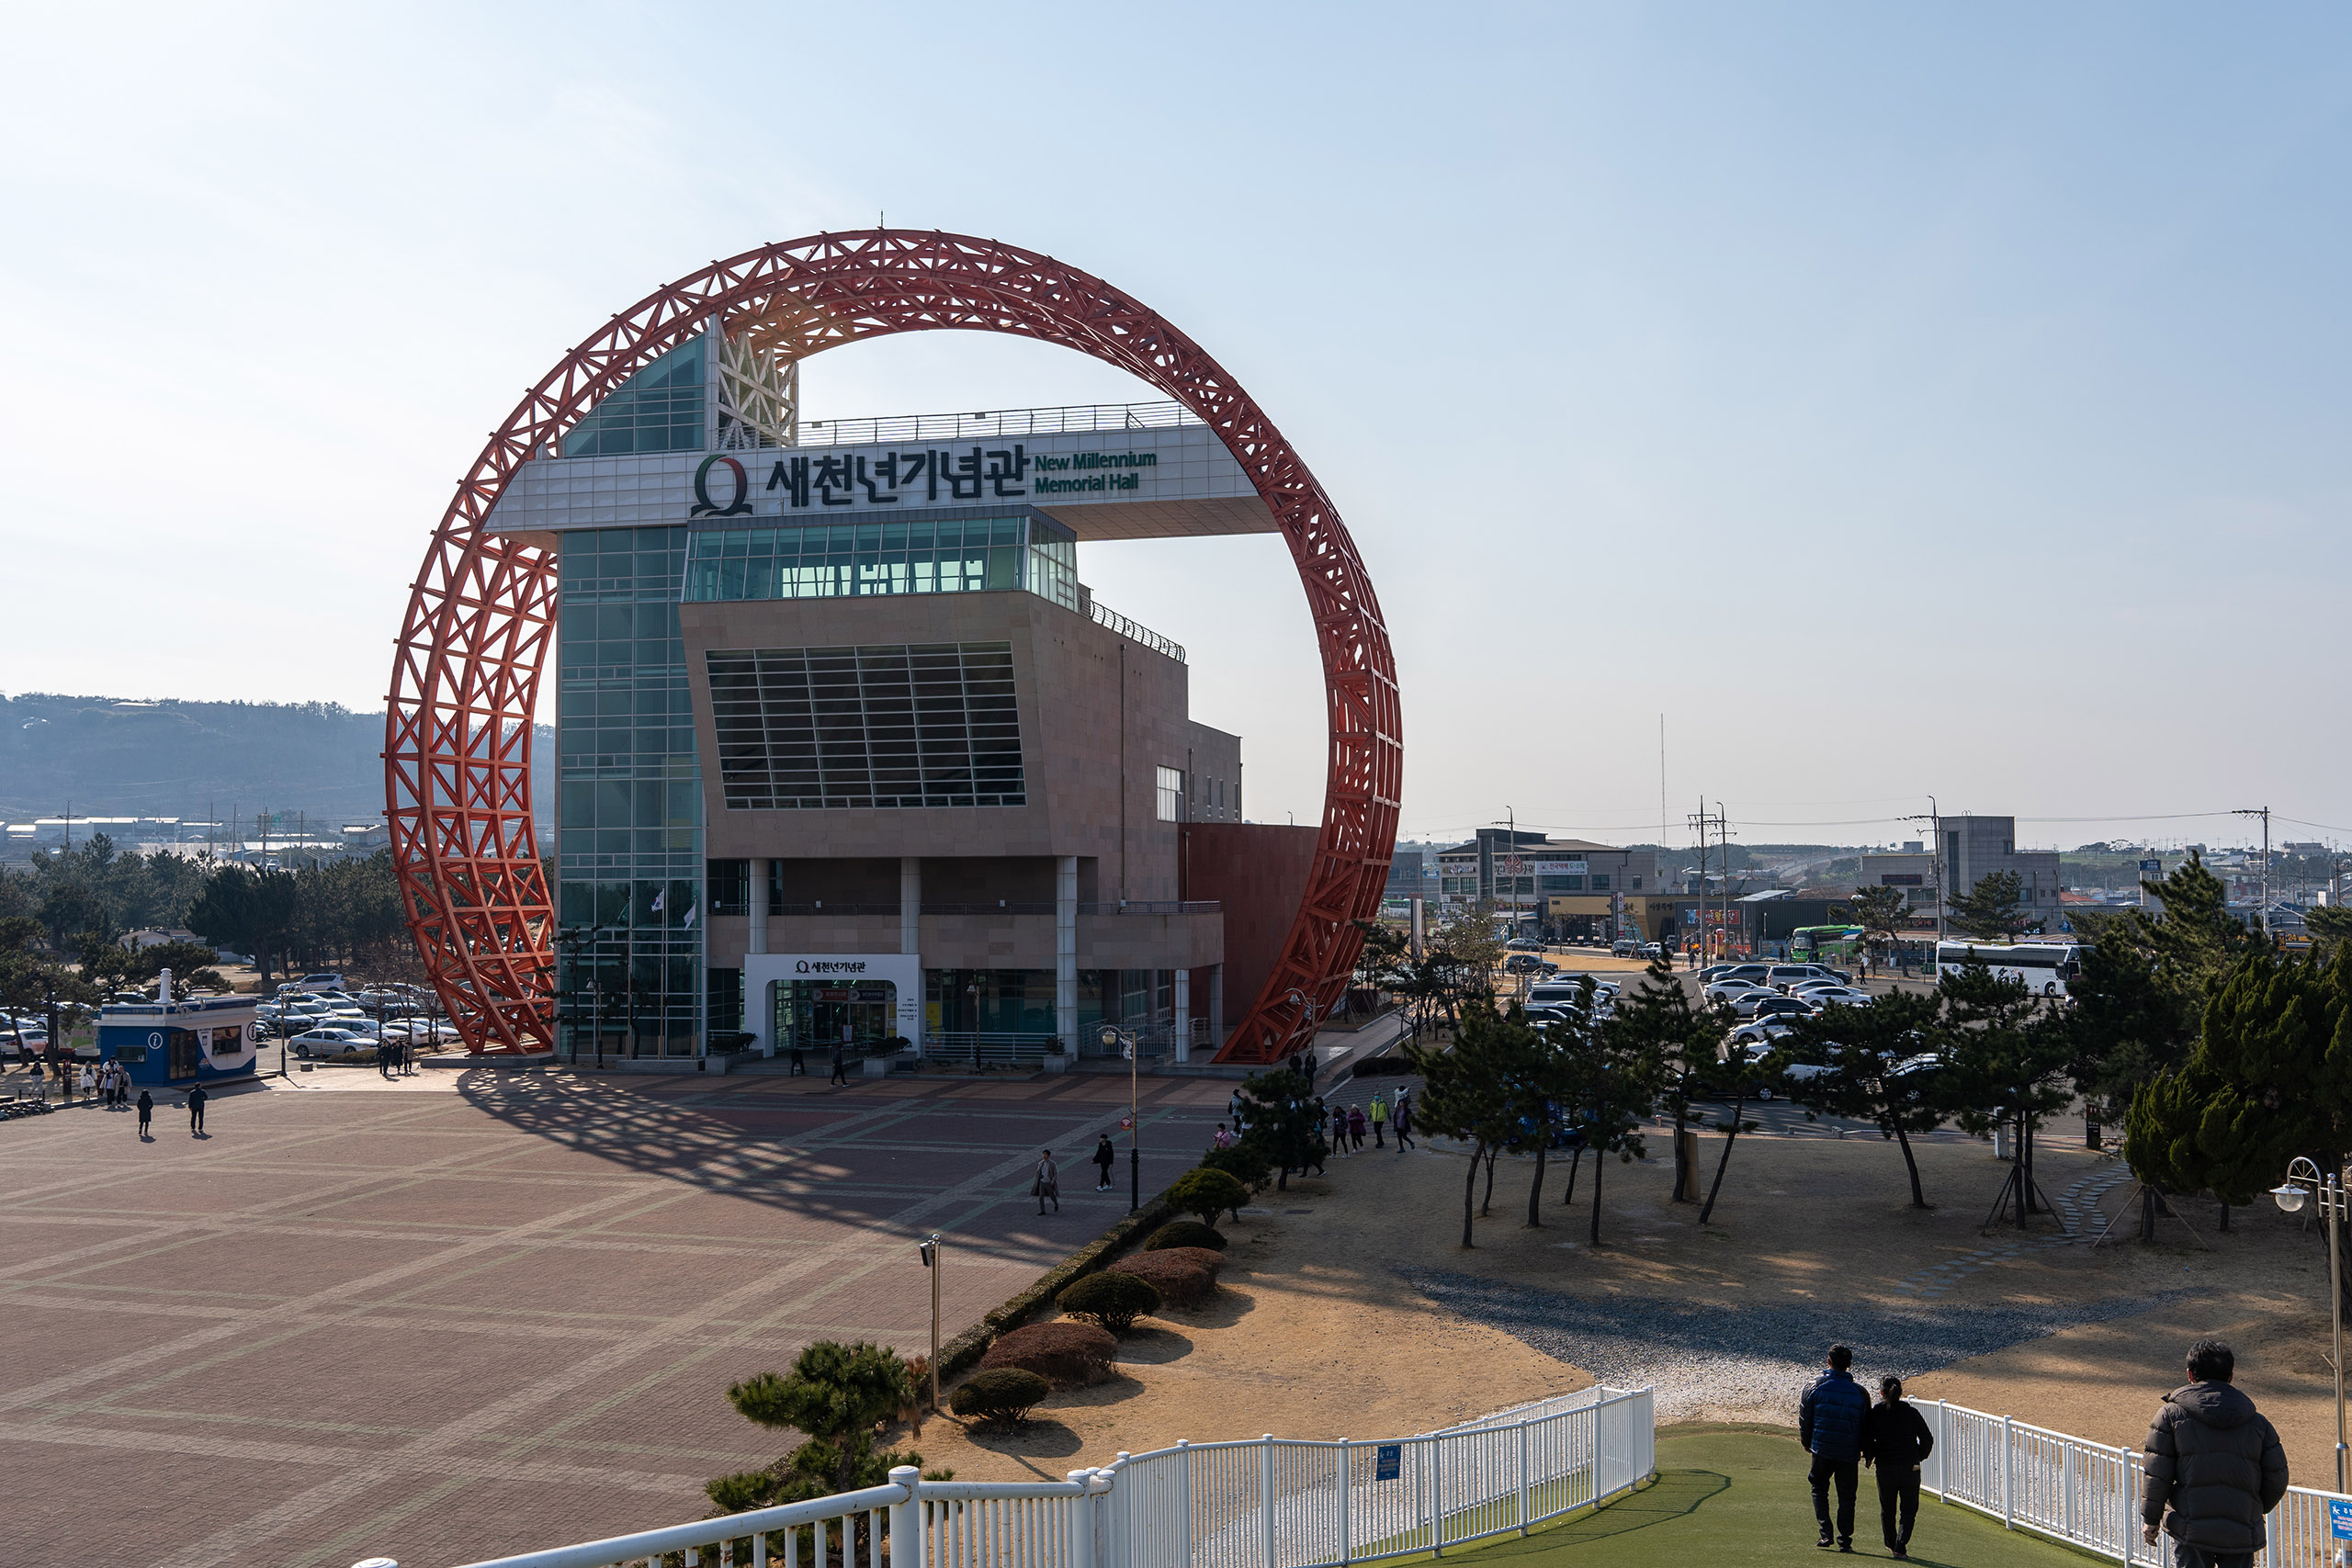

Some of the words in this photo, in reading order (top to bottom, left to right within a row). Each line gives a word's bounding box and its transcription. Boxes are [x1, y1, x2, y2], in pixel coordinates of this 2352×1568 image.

[1035, 454, 1070, 472] New
[1072, 450, 1158, 468] Millennium
[765, 444, 1031, 508] 새천년기념관
[1035, 475, 1106, 494] Memorial
[1109, 472, 1139, 491] Hall
[811, 962, 866, 973] 새천년기념관
